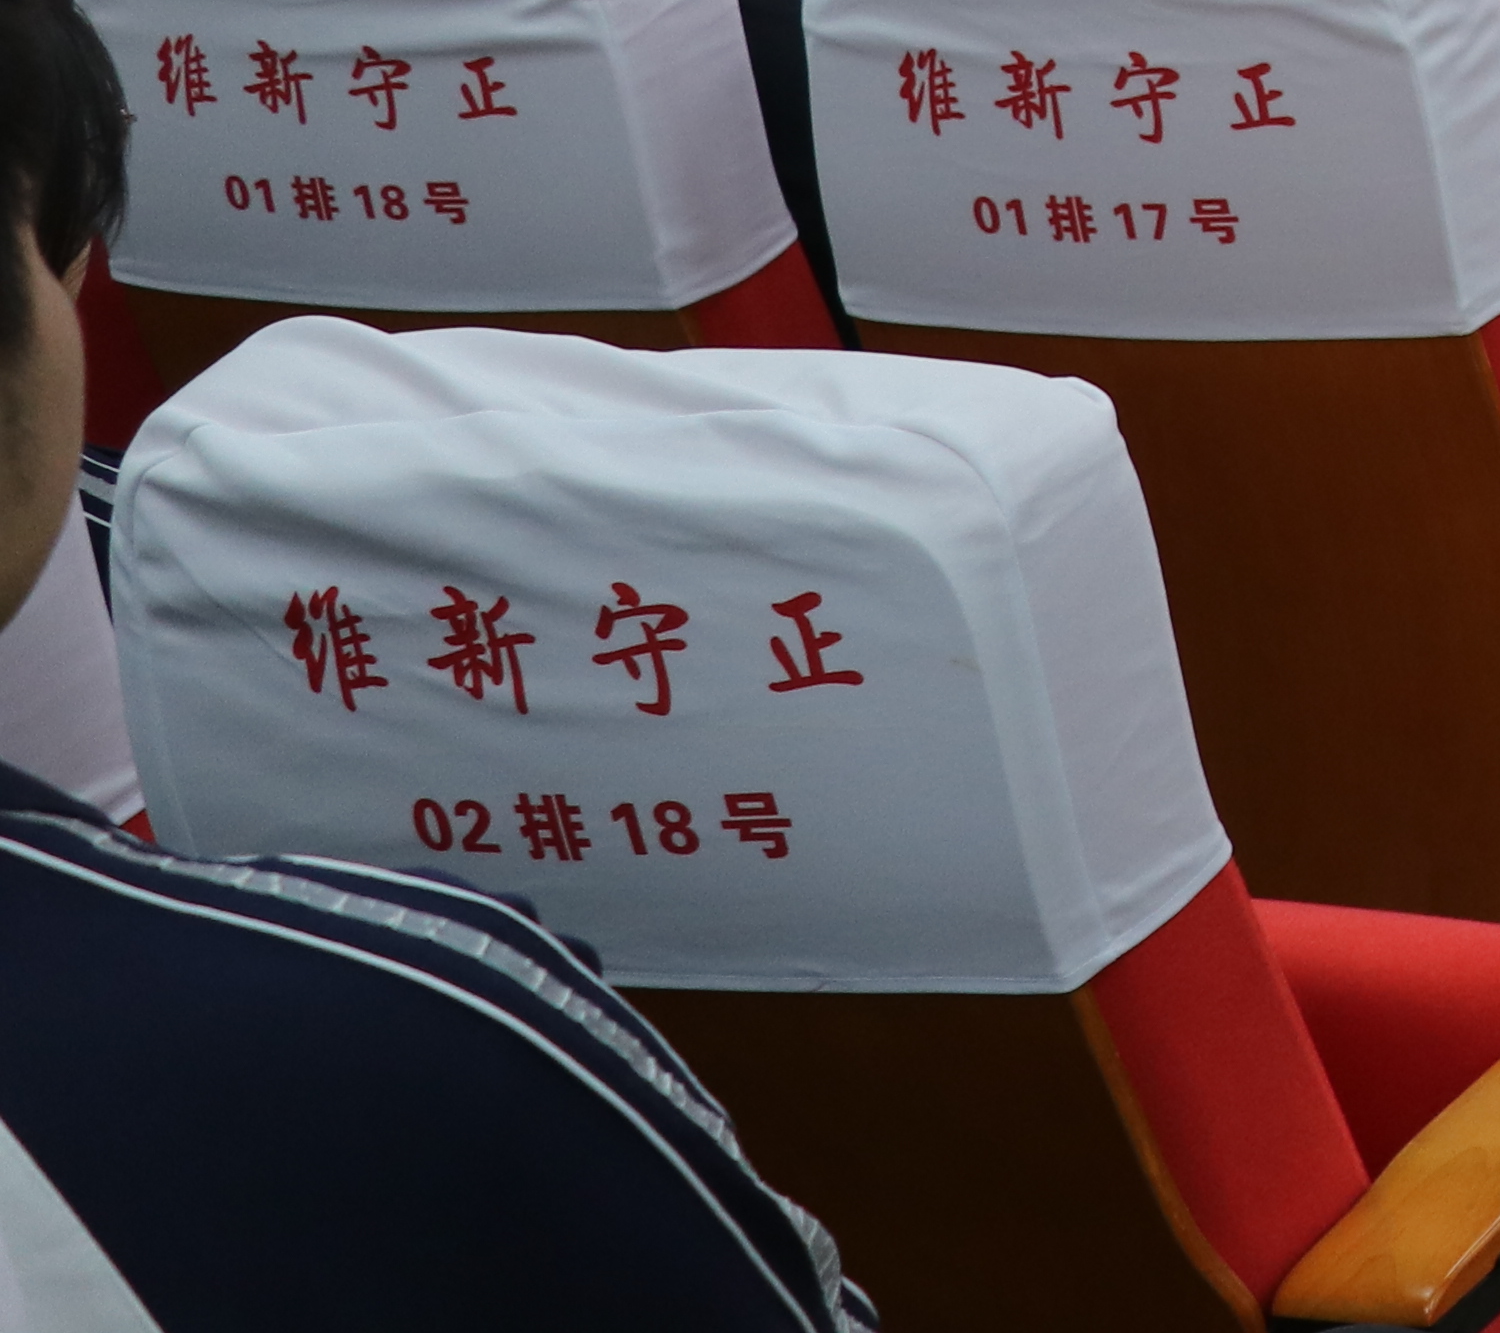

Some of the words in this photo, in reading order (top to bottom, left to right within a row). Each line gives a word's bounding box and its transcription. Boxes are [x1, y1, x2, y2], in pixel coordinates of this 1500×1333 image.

[156, 34, 518, 131] 维新守正
[898, 48, 1297, 145] 维新守正
[224, 174, 470, 226] 01排18号
[972, 194, 1240, 246] 01排17号
[284, 581, 864, 716] 维新守正
[412, 792, 791, 861] 02排18号
